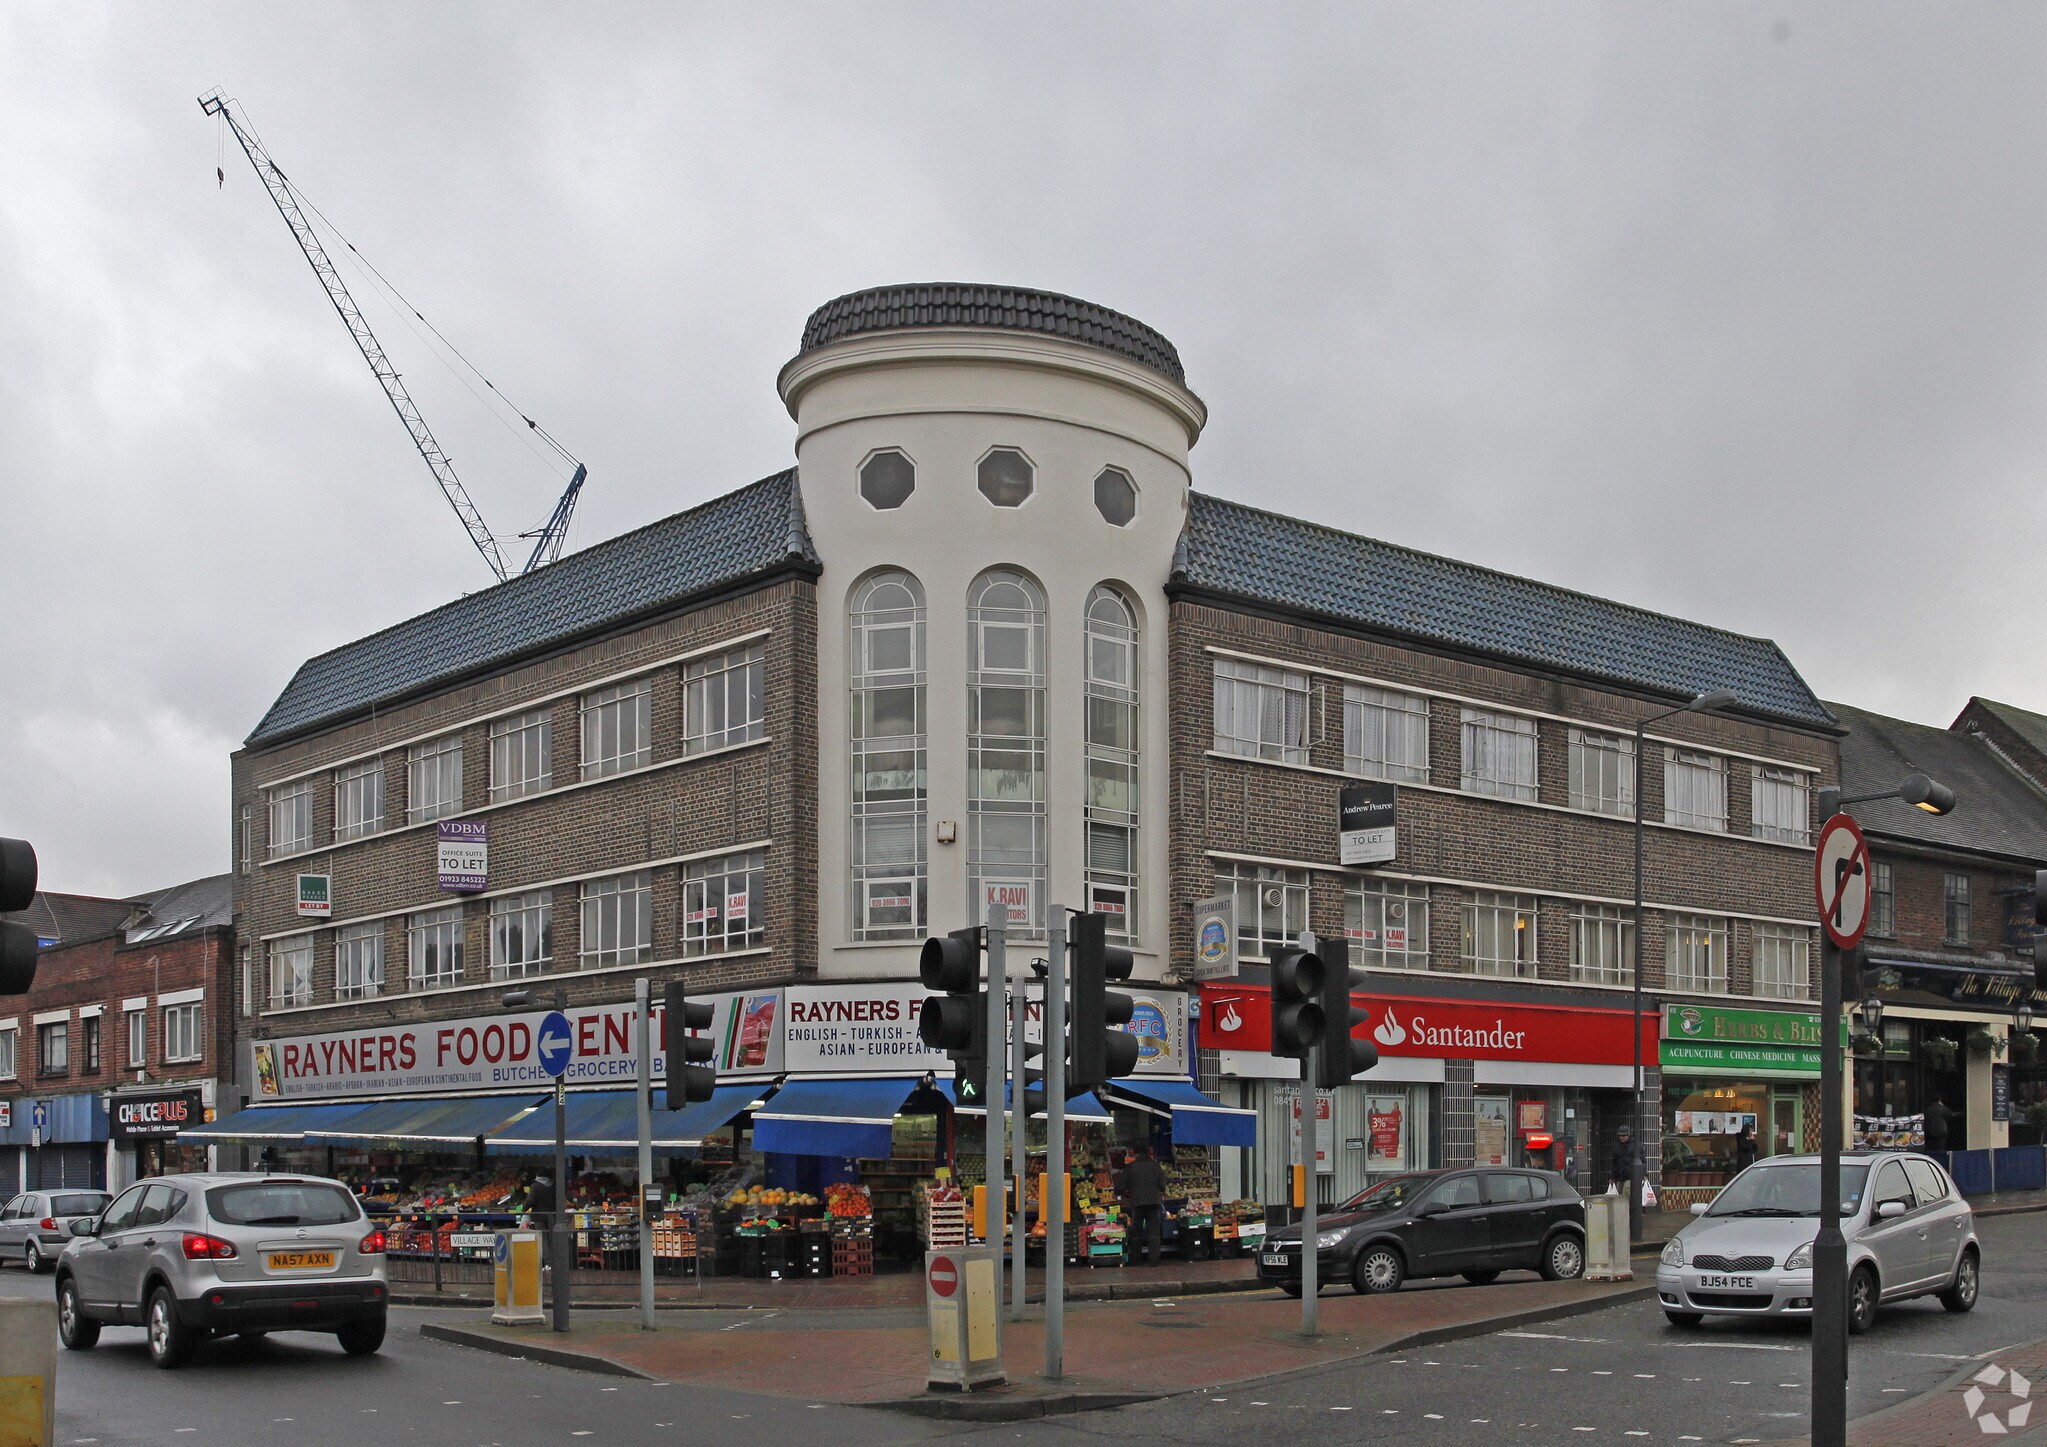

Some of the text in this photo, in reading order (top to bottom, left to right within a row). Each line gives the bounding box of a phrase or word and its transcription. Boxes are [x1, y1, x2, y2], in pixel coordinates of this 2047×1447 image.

[1343, 803, 1393, 814] Andrew Pearce
[440, 823, 486, 834] VDBM
[1352, 834, 1383, 845] TO LET
[441, 858, 485, 870] TO LET
[1196, 900, 1231, 915] SUPERMARKET
[1984, 975, 2022, 1006] Village
[790, 999, 900, 1022] RAYNERS
[788, 1028, 837, 1041] ENGLISH
[851, 1027, 902, 1040] TURKISH
[1128, 1019, 1161, 1035] RFC
[1412, 1016, 1525, 1050] Santander
[1773, 1022, 1784, 1040] &
[437, 1022, 531, 1067] FOOD
[820, 1043, 855, 1056] ASIAN
[868, 1042, 931, 1055] EUROPEAN
[283, 1033, 416, 1078] RAYNERS
[1669, 1048, 1821, 1062] ACUPUNCTURE CHINESE MEDICINE MASS
[493, 1066, 549, 1082] BUTCHE
[567, 1059, 637, 1077] GROCERY
[406, 1075, 430, 1086] EUROPEAN
[435, 1072, 468, 1084] CONTINENTAL
[468, 1072, 482, 1082] FOOD
[1372, 1117, 1387, 1128] 3%
[453, 1236, 480, 1244] VILLAGE
[273, 1253, 329, 1266] NA57 AXN
[1701, 1276, 1753, 1288] BJ54 FCE
